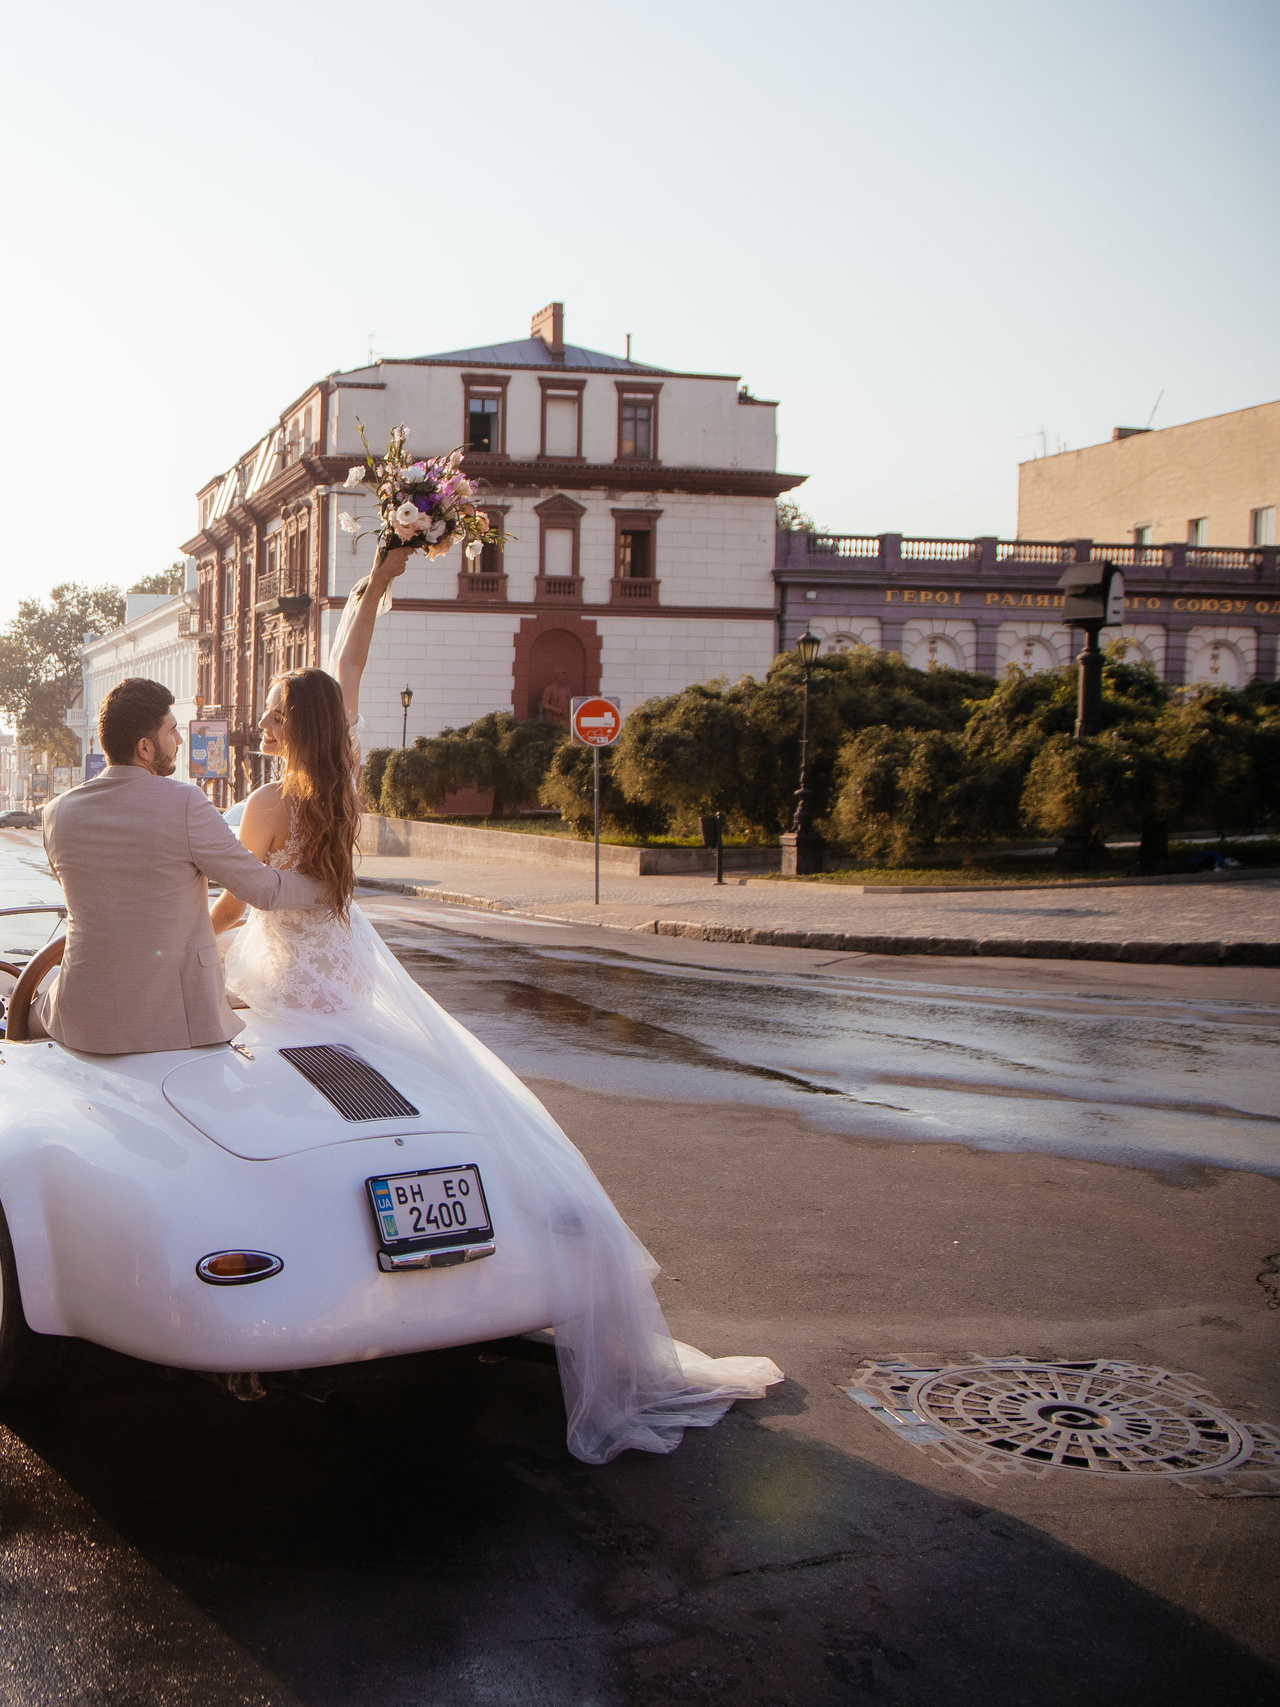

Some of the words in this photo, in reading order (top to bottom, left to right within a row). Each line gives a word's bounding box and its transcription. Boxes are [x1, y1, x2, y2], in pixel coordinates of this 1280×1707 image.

[985, 592, 1161, 611] РАДЯНГО
[1172, 597, 1248, 614] СОЮЗУ
[378, 1198, 392, 1209] UA
[395, 1184, 424, 1205] BH
[443, 1178, 470, 1198] EO
[409, 1200, 467, 1233] 2400
